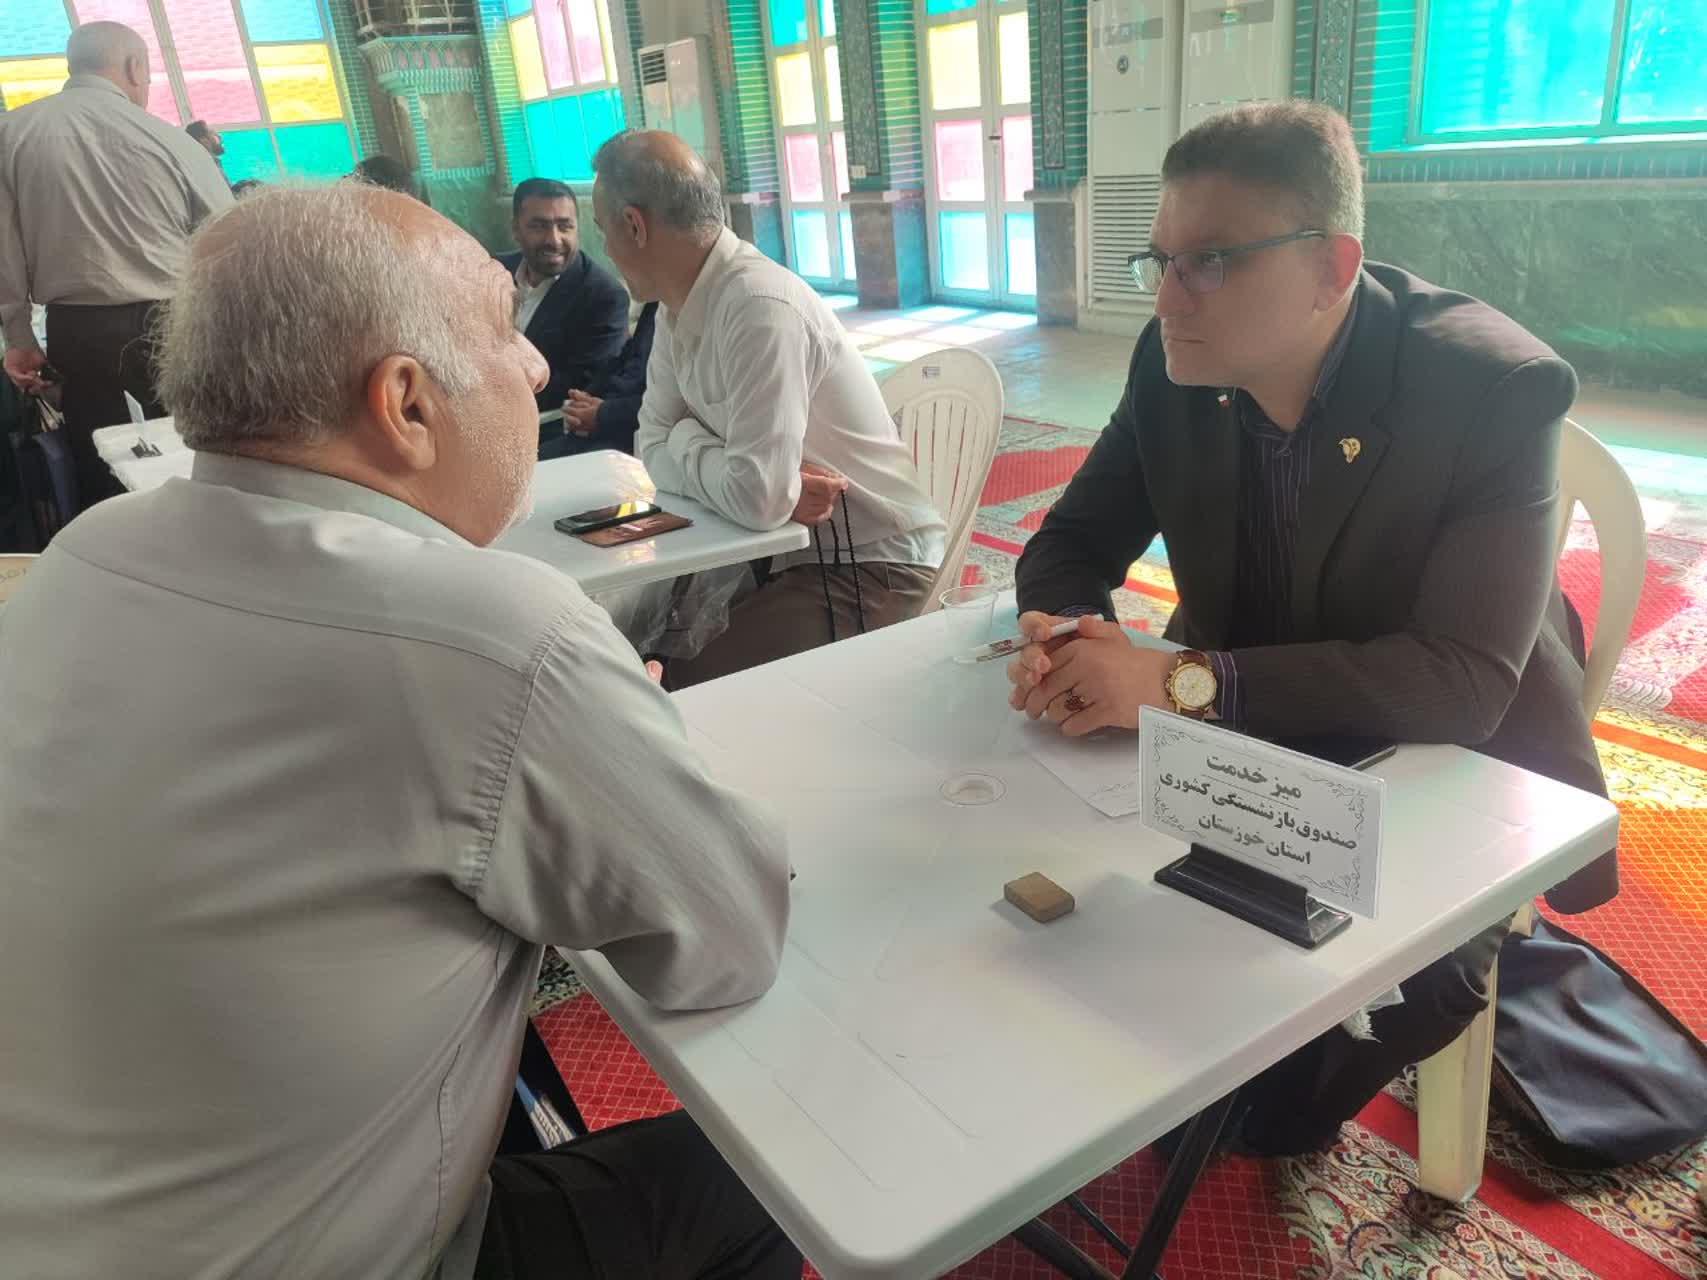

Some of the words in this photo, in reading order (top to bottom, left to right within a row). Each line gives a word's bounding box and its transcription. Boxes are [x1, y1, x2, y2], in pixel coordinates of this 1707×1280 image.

[1206, 755, 1267, 783] خدمت
[1159, 772, 1211, 796] کشوری
[1271, 776, 1302, 800] میز
[1198, 814, 1265, 846] خوزستان
[1296, 822, 1358, 850] صندوق
[1266, 841, 1311, 865] استان
